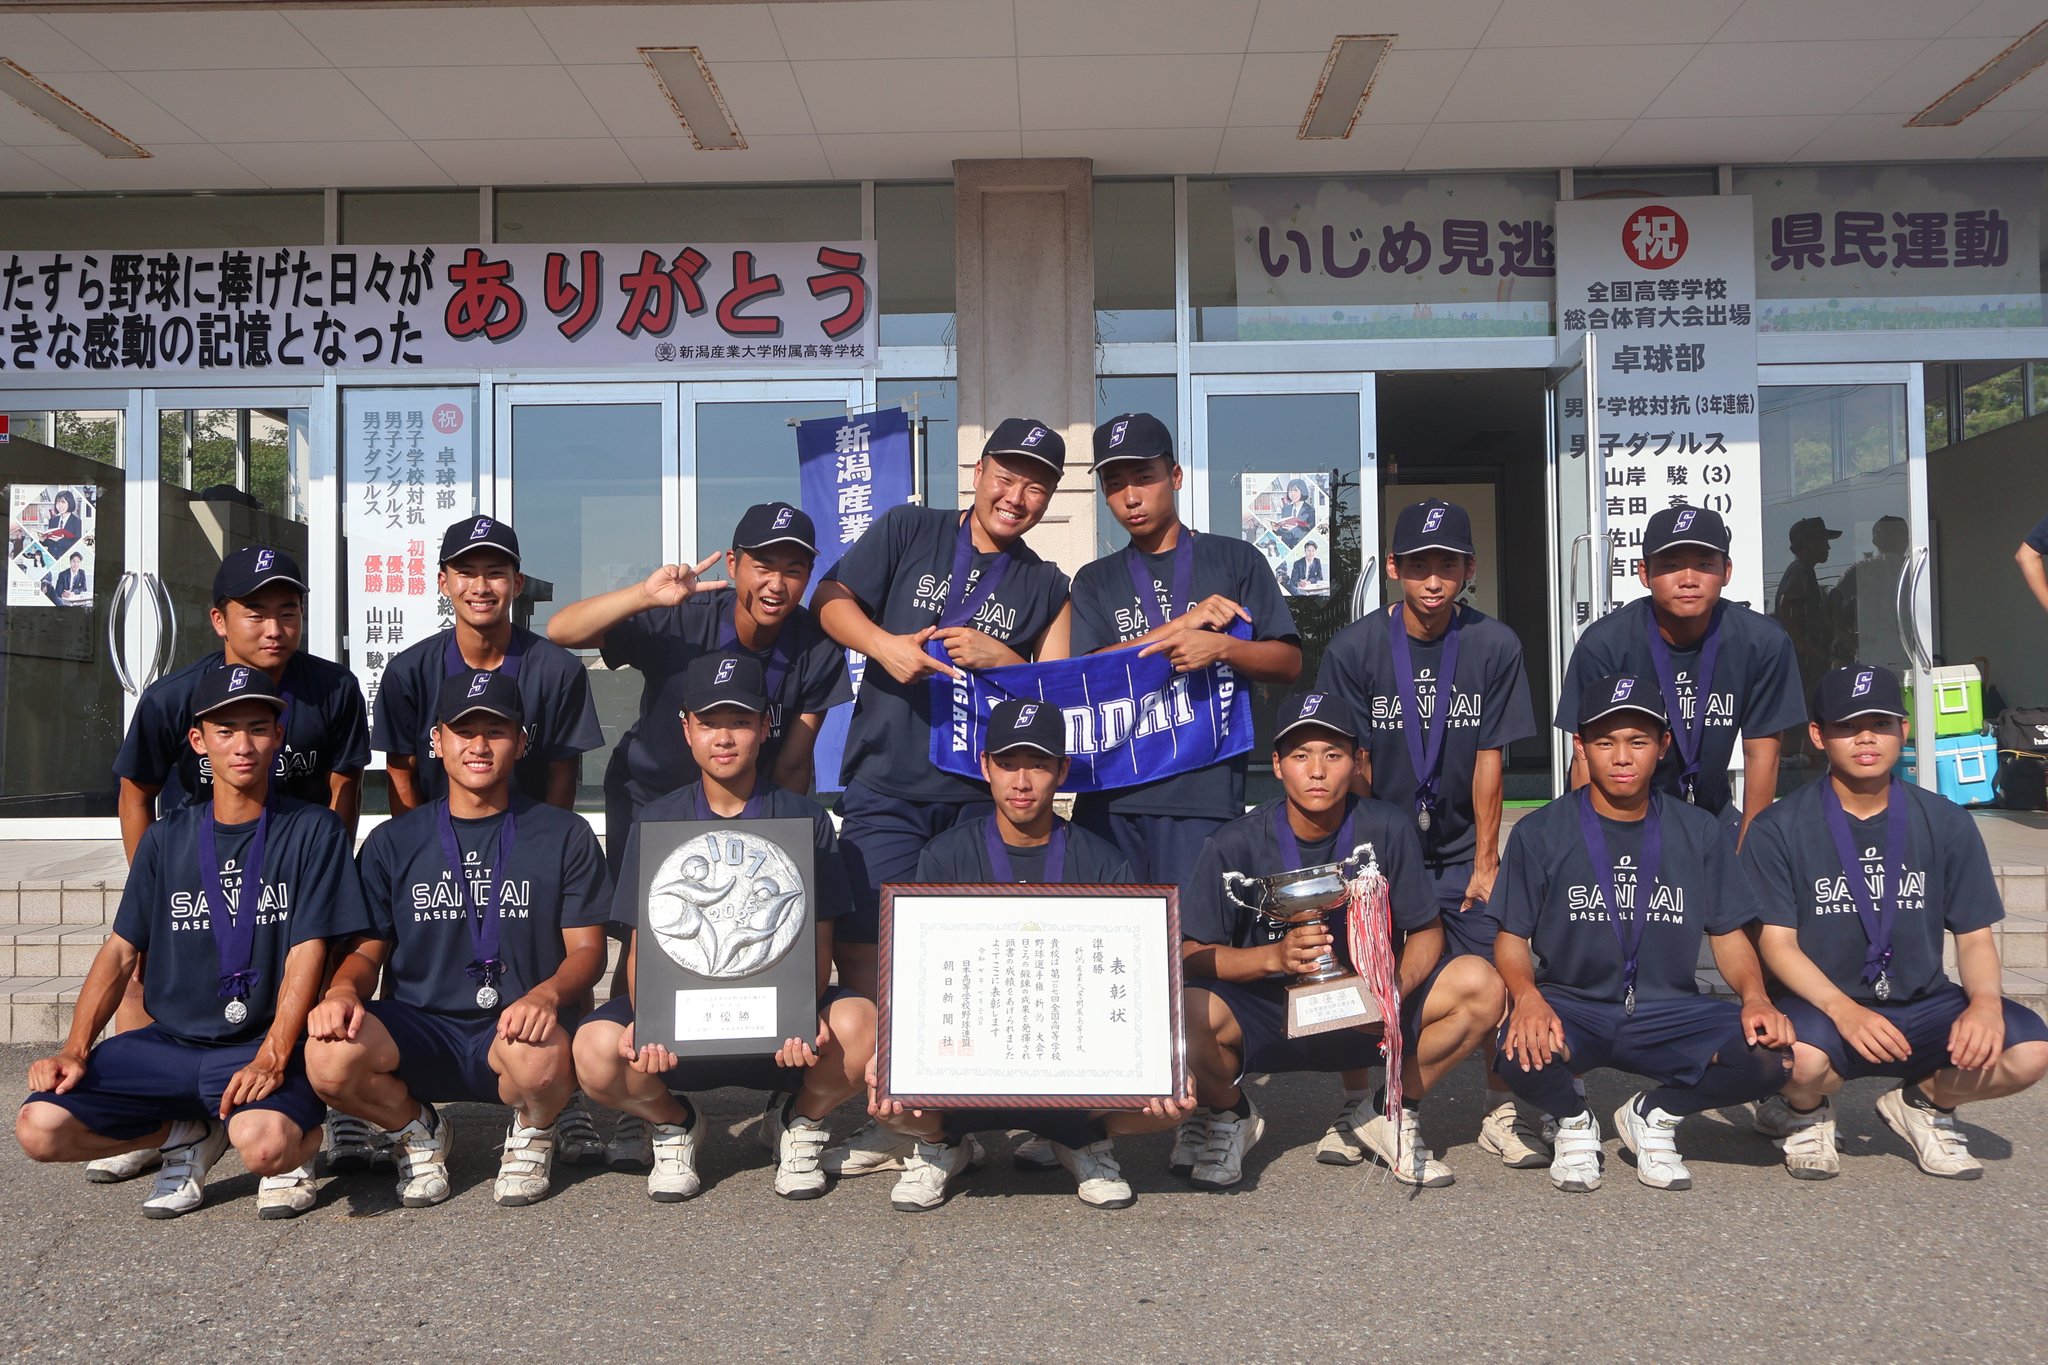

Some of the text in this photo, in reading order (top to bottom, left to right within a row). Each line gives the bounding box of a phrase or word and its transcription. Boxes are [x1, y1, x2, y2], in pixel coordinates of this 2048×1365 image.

[1632, 215, 1680, 261] 祝
[1770, 209, 2009, 271] 県民運動
[3, 247, 434, 312] たすら野球に捧げた日々が
[1587, 277, 1728, 304] 全国高等学校
[445, 246, 865, 341] ありがとう
[1563, 303, 1751, 332] 総合体育大会出場
[0, 308, 423, 370] きな感動の記憶となった
[680, 344, 864, 359] 新潟産業大学附属高等学校
[1611, 343, 1706, 375] 卓球部
[437, 410, 457, 429] 祝
[1021, 426, 1047, 446] S
[1109, 420, 1128, 448] S
[1569, 431, 1728, 460] 男子ダブルス
[362, 411, 381, 516] 男子ダブルス
[384, 411, 403, 530] 男子シングルス
[1605, 464, 1732, 487] 山岸 駿 (3)
[436, 446, 456, 510] 卓球部
[834, 423, 873, 544] 新潟産業
[406, 411, 426, 596] 男子学校対抗 初優勝
[1605, 496, 1648, 517] 吉田
[470, 518, 493, 540] S
[772, 508, 794, 530] S
[1422, 508, 1445, 533] S
[1673, 510, 1696, 533] S
[254, 550, 275, 573] S
[364, 555, 383, 593] 優勝
[385, 555, 404, 594] 優勝
[366, 606, 384, 645] 山岸
[387, 606, 404, 645] 山岸
[976, 622, 1010, 641] TEAM
[228, 667, 250, 692] S
[714, 658, 737, 684] S
[1851, 671, 1873, 698] S
[467, 673, 492, 698] S
[1611, 678, 1634, 703] S
[1014, 704, 1039, 729] S
[1299, 694, 1322, 719] S
[1446, 718, 1481, 729] TEAM
[1704, 718, 1733, 727] EAM
[706, 834, 767, 879] 107
[256, 911, 289, 926] TEAM
[500, 908, 529, 919] EAM
[709, 900, 759, 926] 2025
[1646, 913, 1684, 925] TEAM
[1092, 937, 1106, 975] 準優勝
[942, 960, 954, 1048] 朝日新聞社
[961, 960, 972, 1048] 日本高等学校野球連盟
[1109, 957, 1128, 1024] 表彰状
